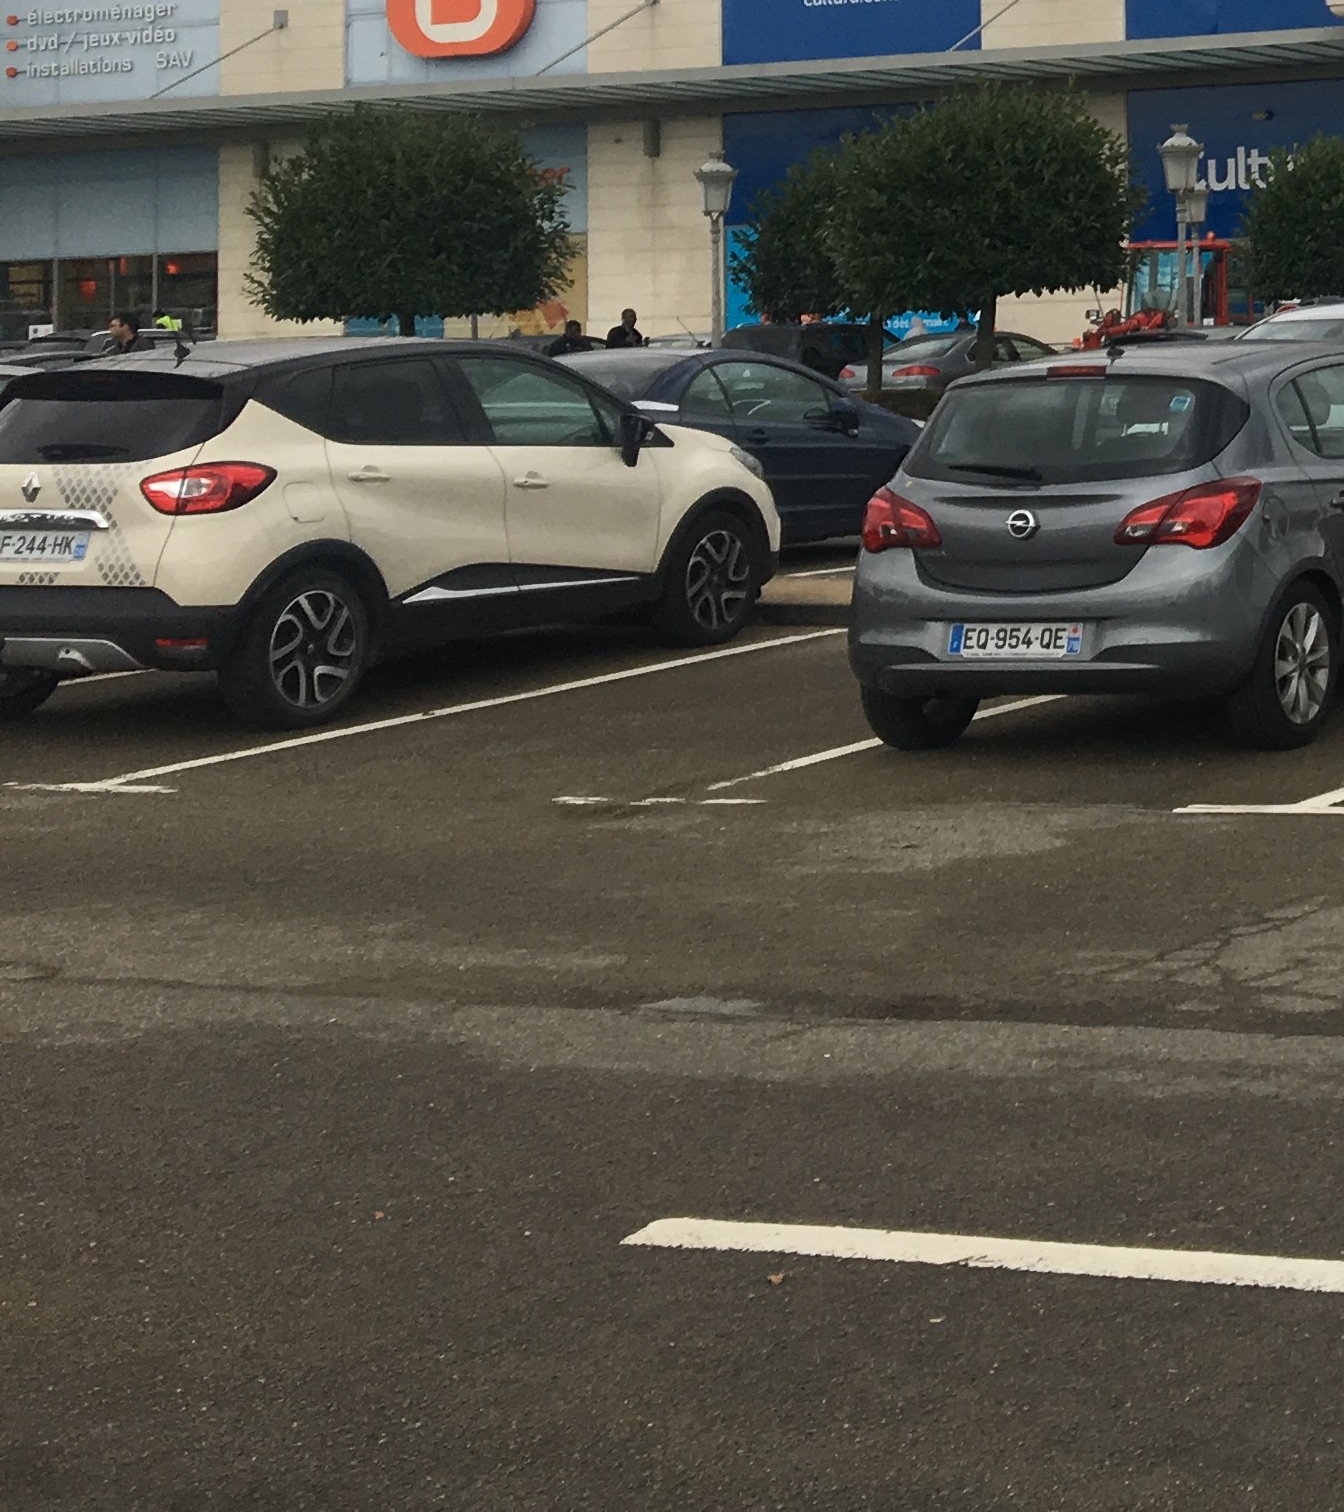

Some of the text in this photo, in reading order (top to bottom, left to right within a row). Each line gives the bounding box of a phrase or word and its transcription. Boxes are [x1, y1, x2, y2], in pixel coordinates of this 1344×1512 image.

[27, 1, 177, 25] électroménager
[27, 33, 60, 52] dvd
[82, 30, 121, 53] jeux
[127, 25, 177, 46] vidéo
[26, 49, 194, 78] installations SAV
[962, 627, 1068, 650] EQ-954-QE
